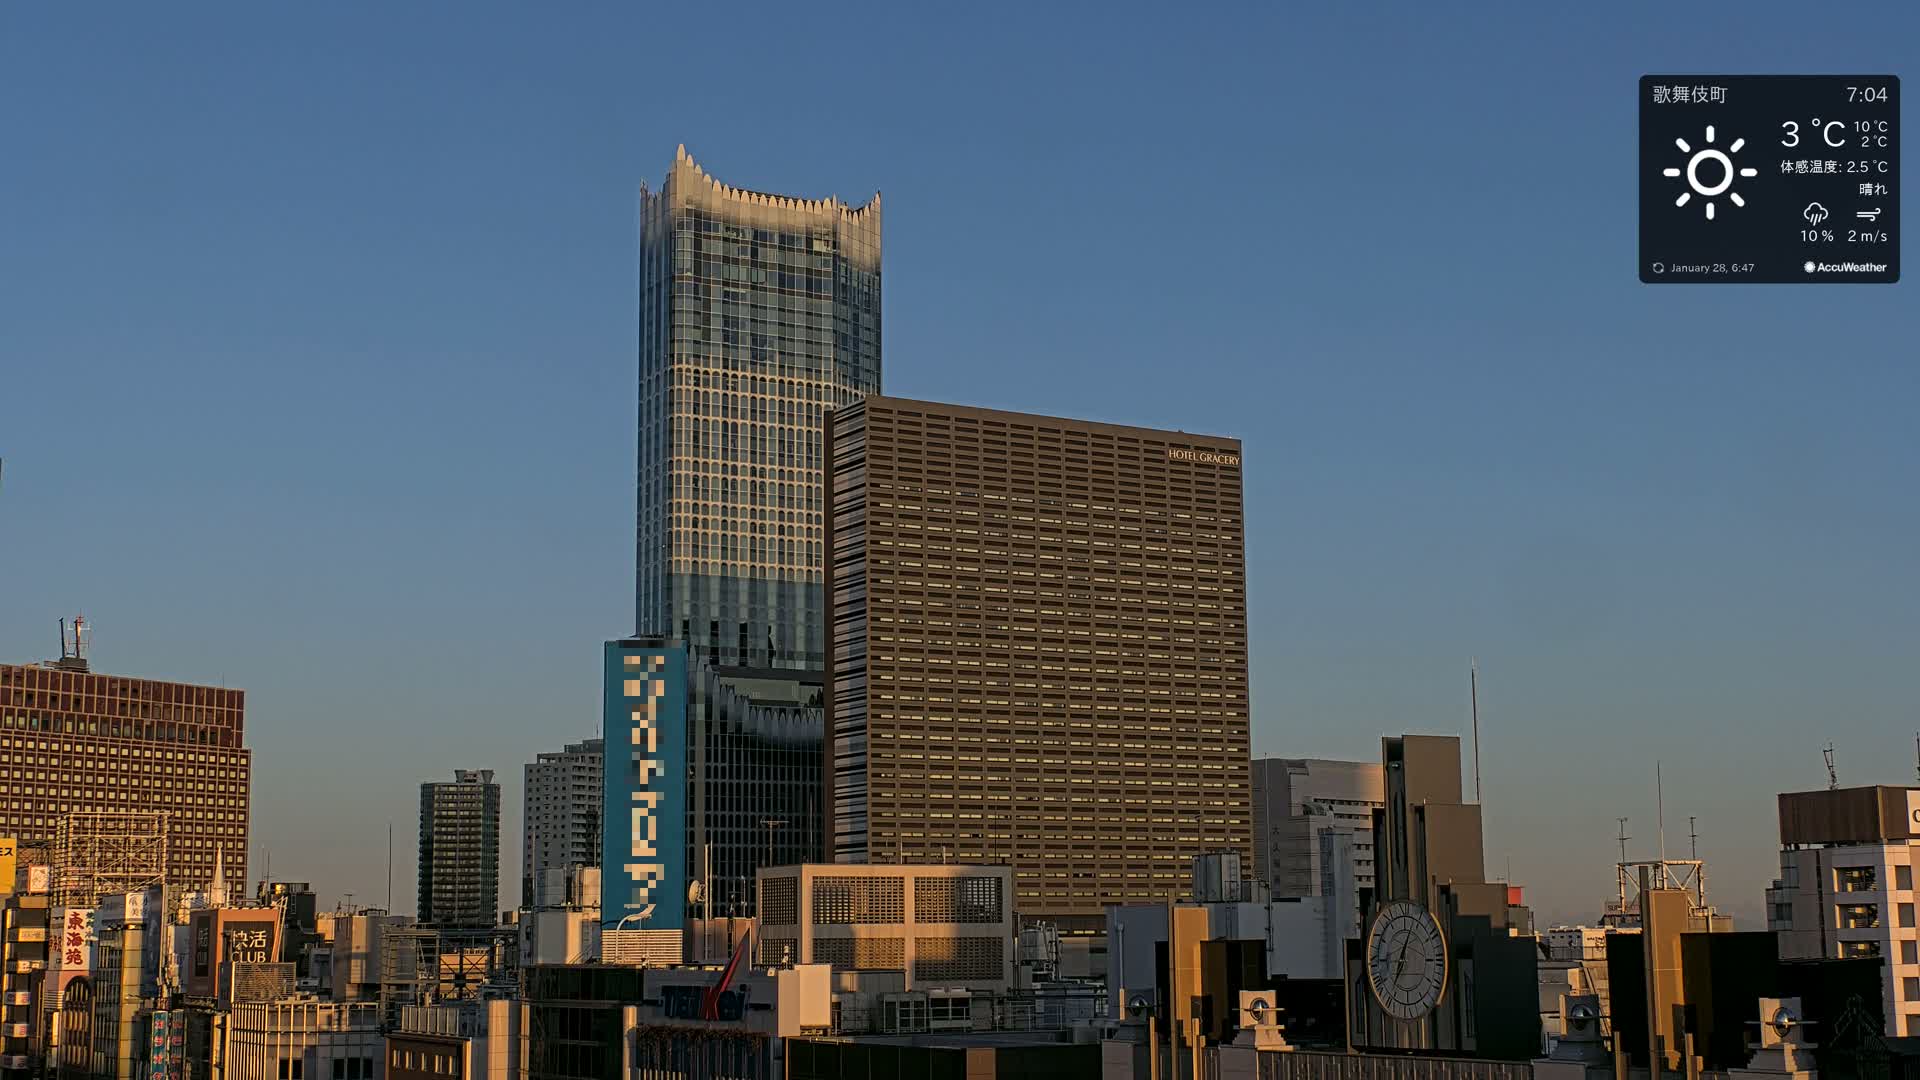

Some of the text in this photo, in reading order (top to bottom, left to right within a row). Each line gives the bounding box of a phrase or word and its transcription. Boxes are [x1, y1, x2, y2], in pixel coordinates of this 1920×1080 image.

[1169, 449, 1240, 465] HOTEL GRACERY
[64, 911, 85, 965] 東海苑
[232, 930, 267, 948] 快活
[231, 951, 267, 963] CLUB
